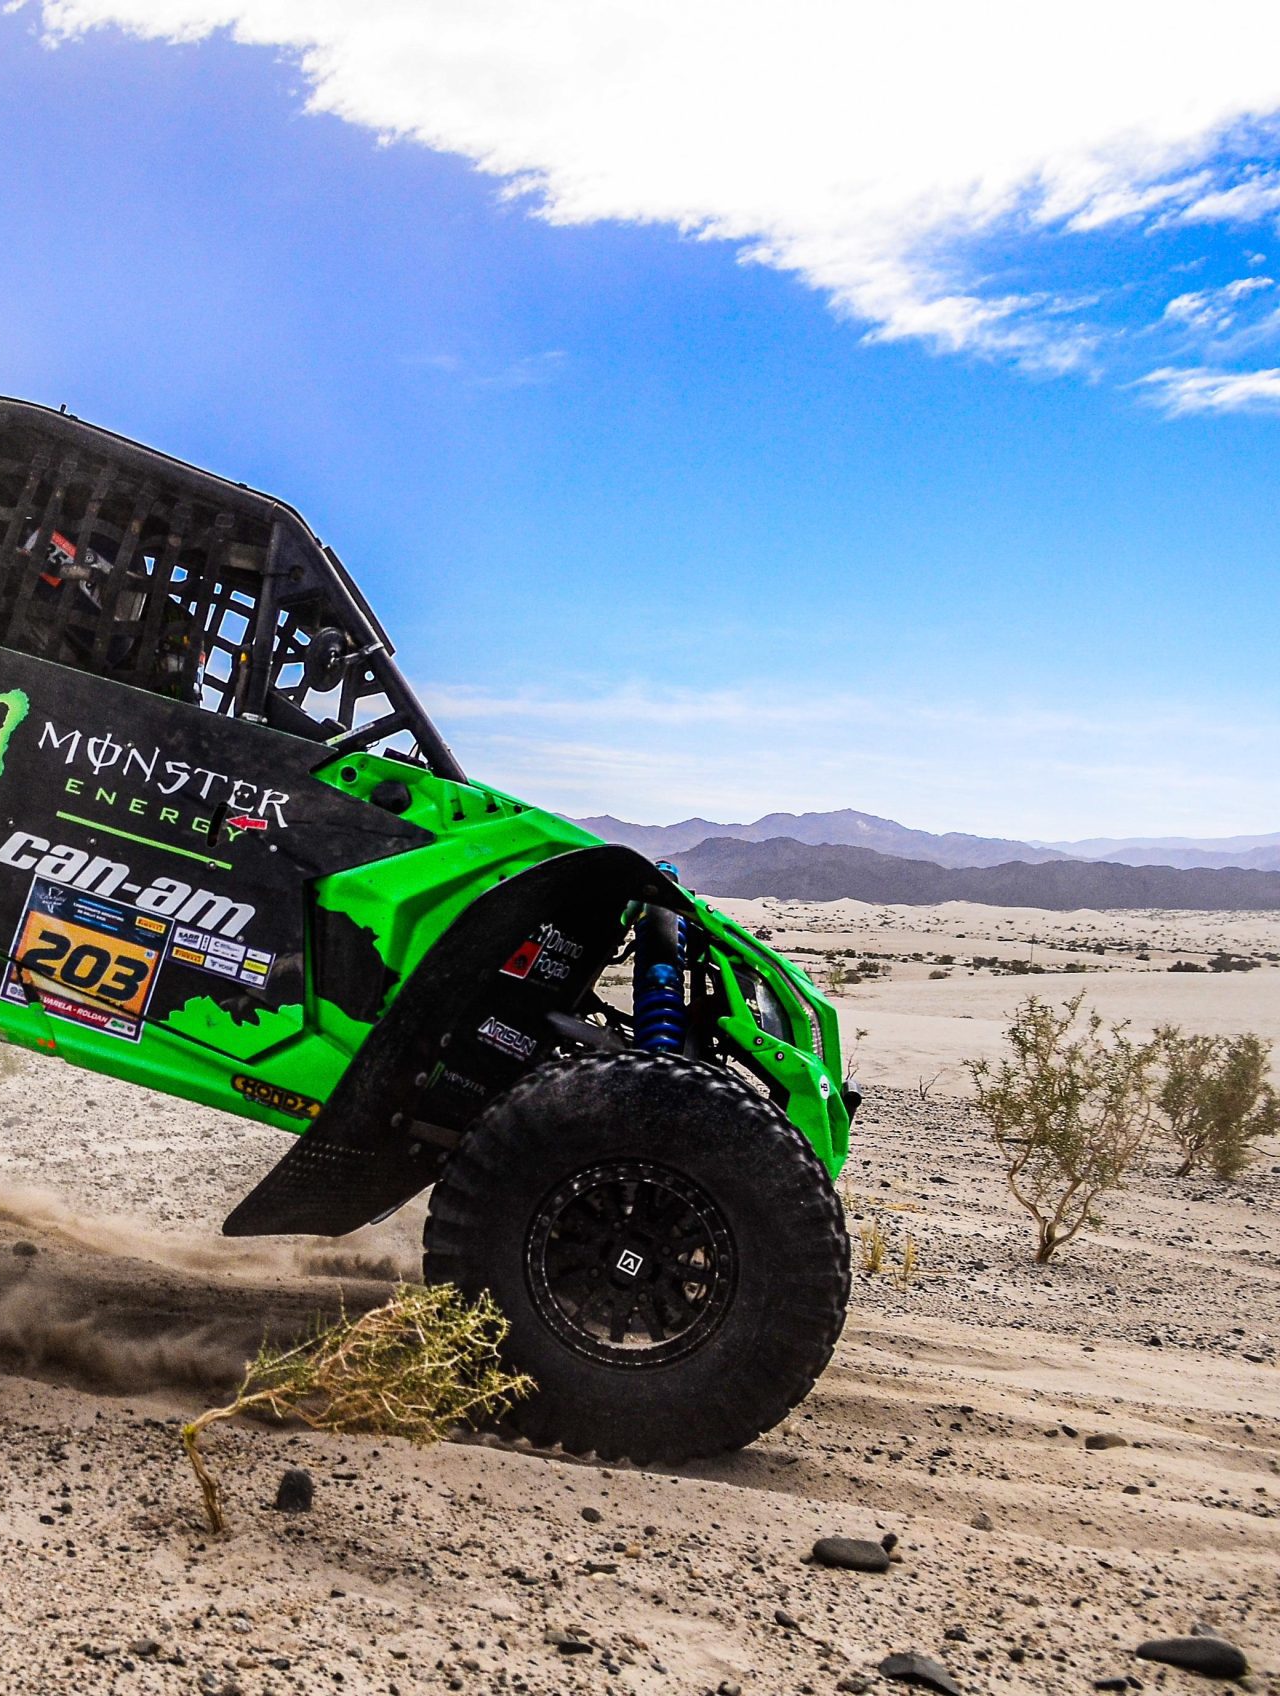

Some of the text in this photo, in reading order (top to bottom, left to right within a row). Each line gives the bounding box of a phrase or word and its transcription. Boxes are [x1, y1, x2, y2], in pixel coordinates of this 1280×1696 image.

[64, 777, 246, 843] ENERGY
[546, 929, 584, 959] Divino
[22, 929, 150, 1003] 203
[533, 951, 571, 979] Fogão
[43, 995, 72, 1012] VARELA
[77, 1006, 109, 1024] ROLDAN
[477, 1016, 538, 1056] ARISUN
